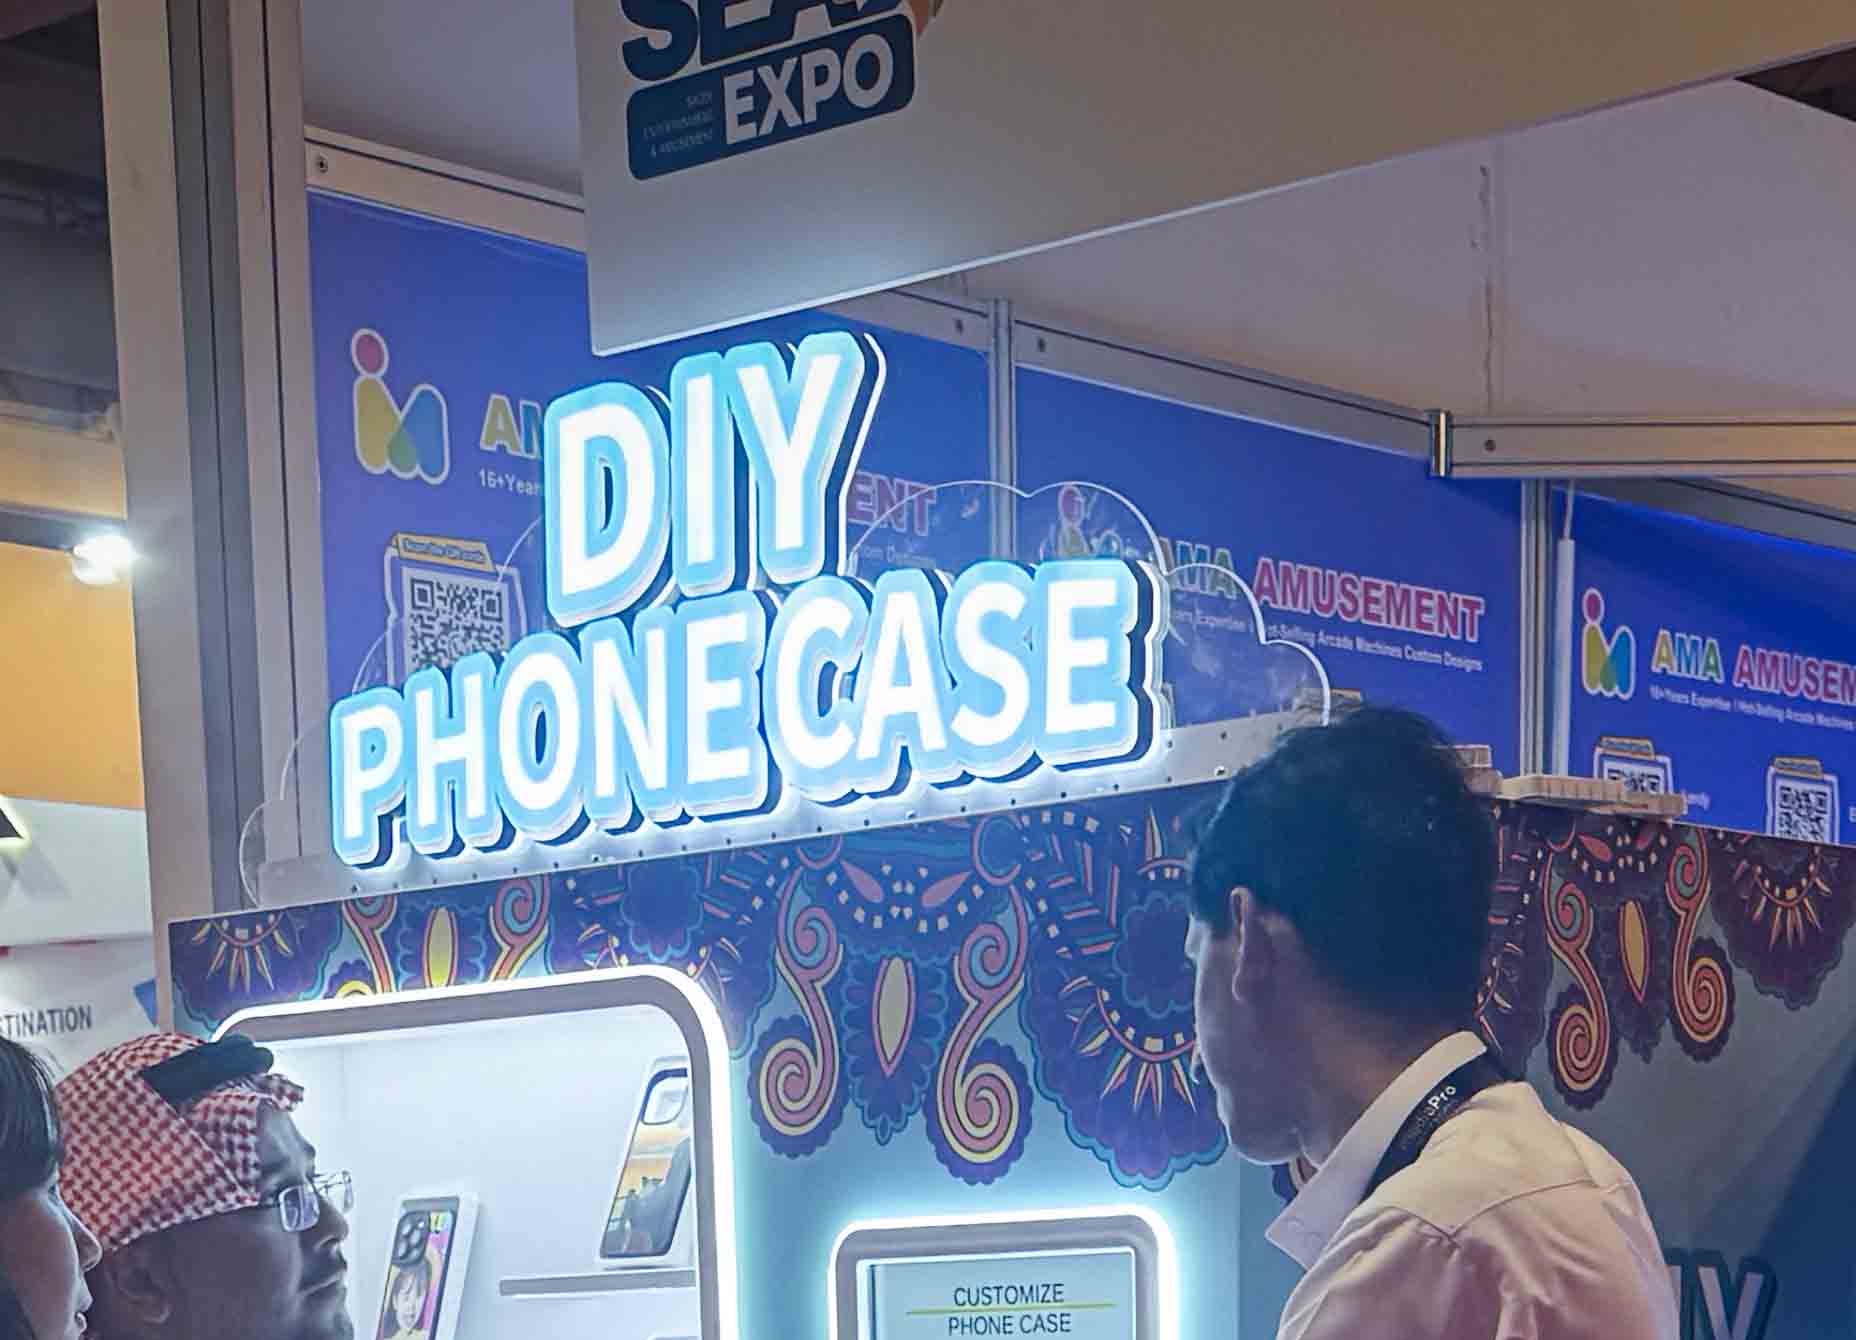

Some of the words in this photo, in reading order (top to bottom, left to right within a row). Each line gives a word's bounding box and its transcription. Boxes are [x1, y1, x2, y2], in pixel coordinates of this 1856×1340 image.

[723, 34, 894, 145] EXPO
[546, 332, 868, 628] DIY
[1253, 556, 1485, 644] AMUSEMENT
[1651, 628, 1725, 685] AMA
[330, 590, 768, 864] PHONE
[762, 557, 1142, 797] CASE
[948, 1315, 1014, 1337] PHONE
[1019, 1312, 1072, 1334] CASE
[953, 1283, 1065, 1307] CUSTOMIZE
